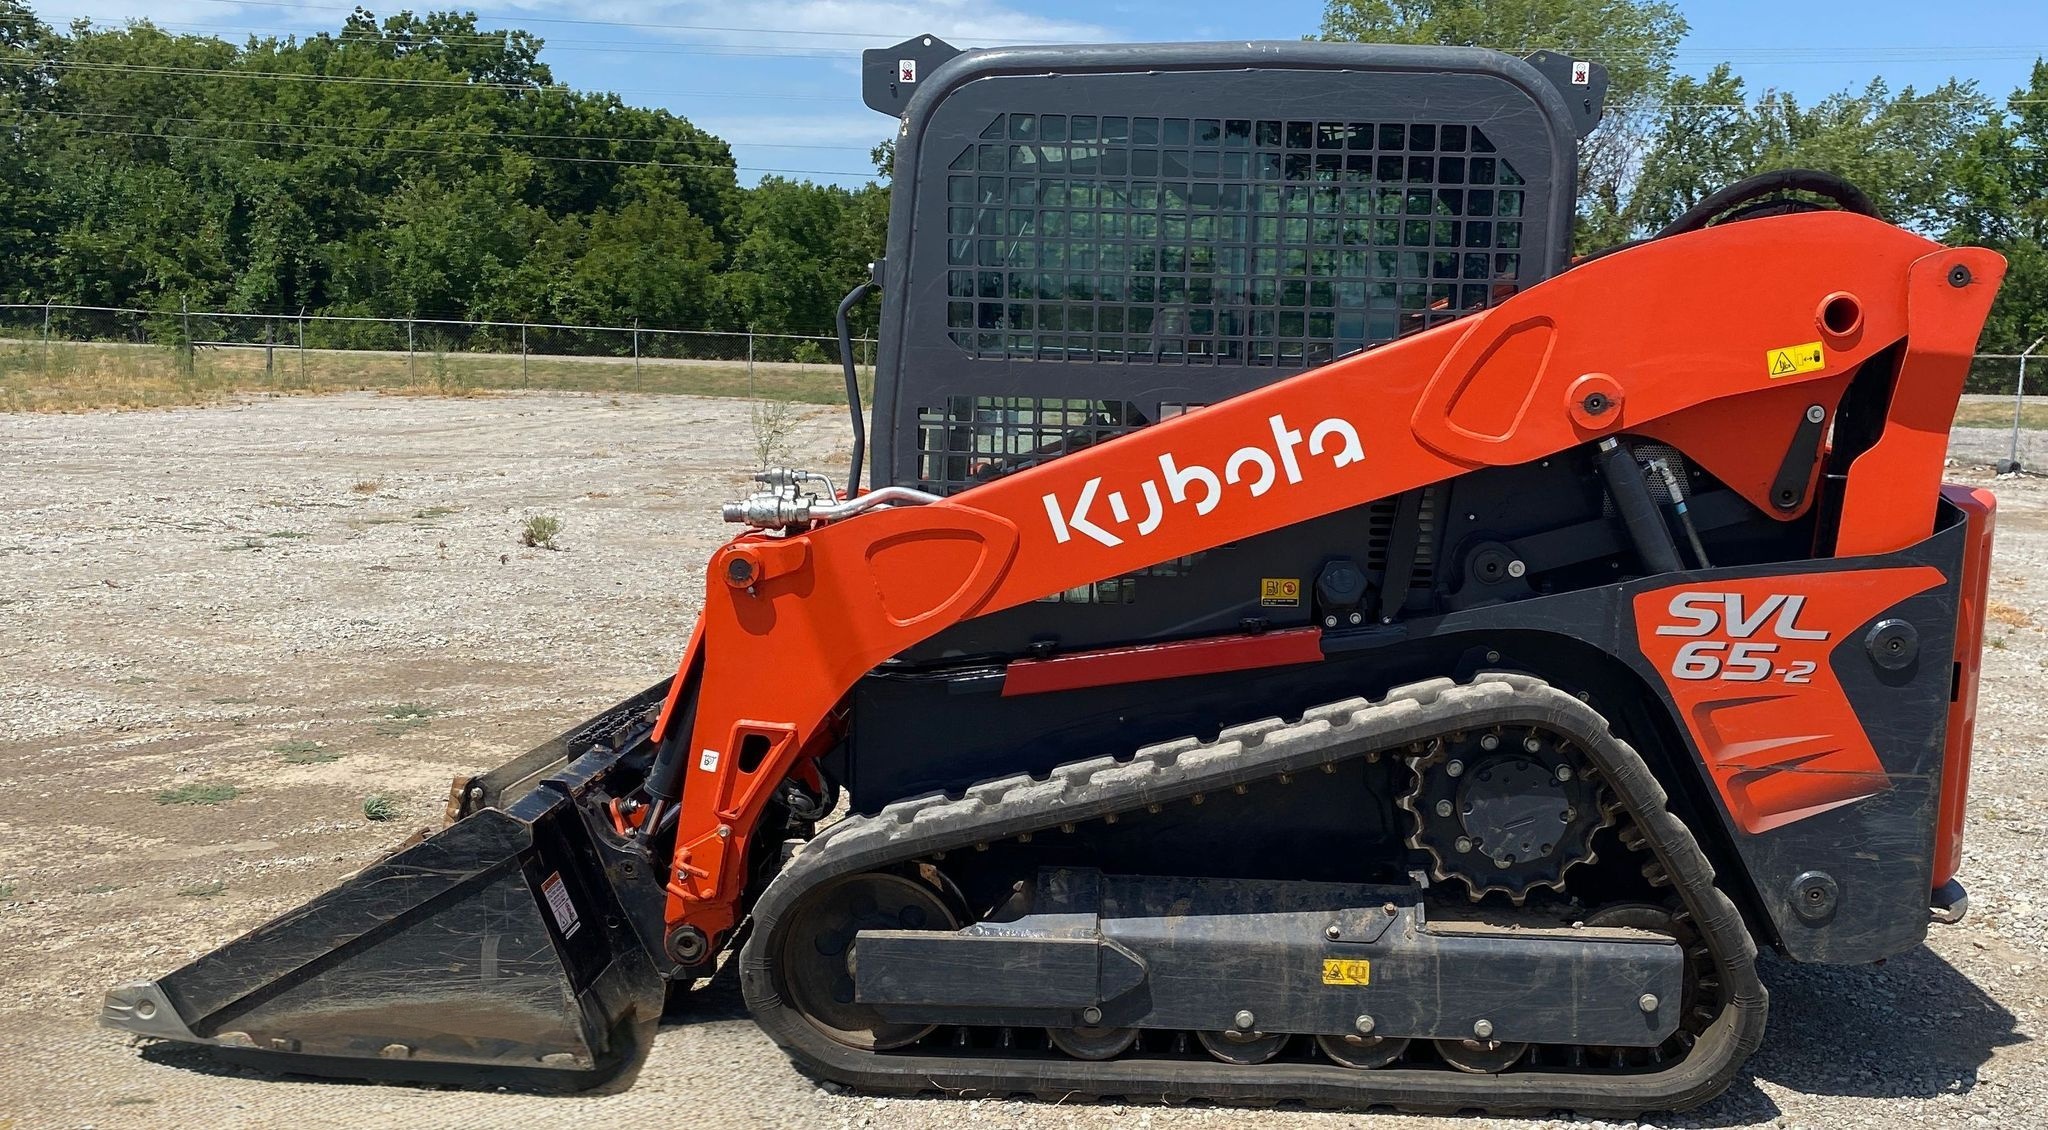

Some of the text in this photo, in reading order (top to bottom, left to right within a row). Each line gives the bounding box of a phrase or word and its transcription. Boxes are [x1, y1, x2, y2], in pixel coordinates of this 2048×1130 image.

[1042, 414, 1366, 548] Kubota
[1655, 591, 1831, 640] SVL
[1671, 640, 1818, 684] 65-2
